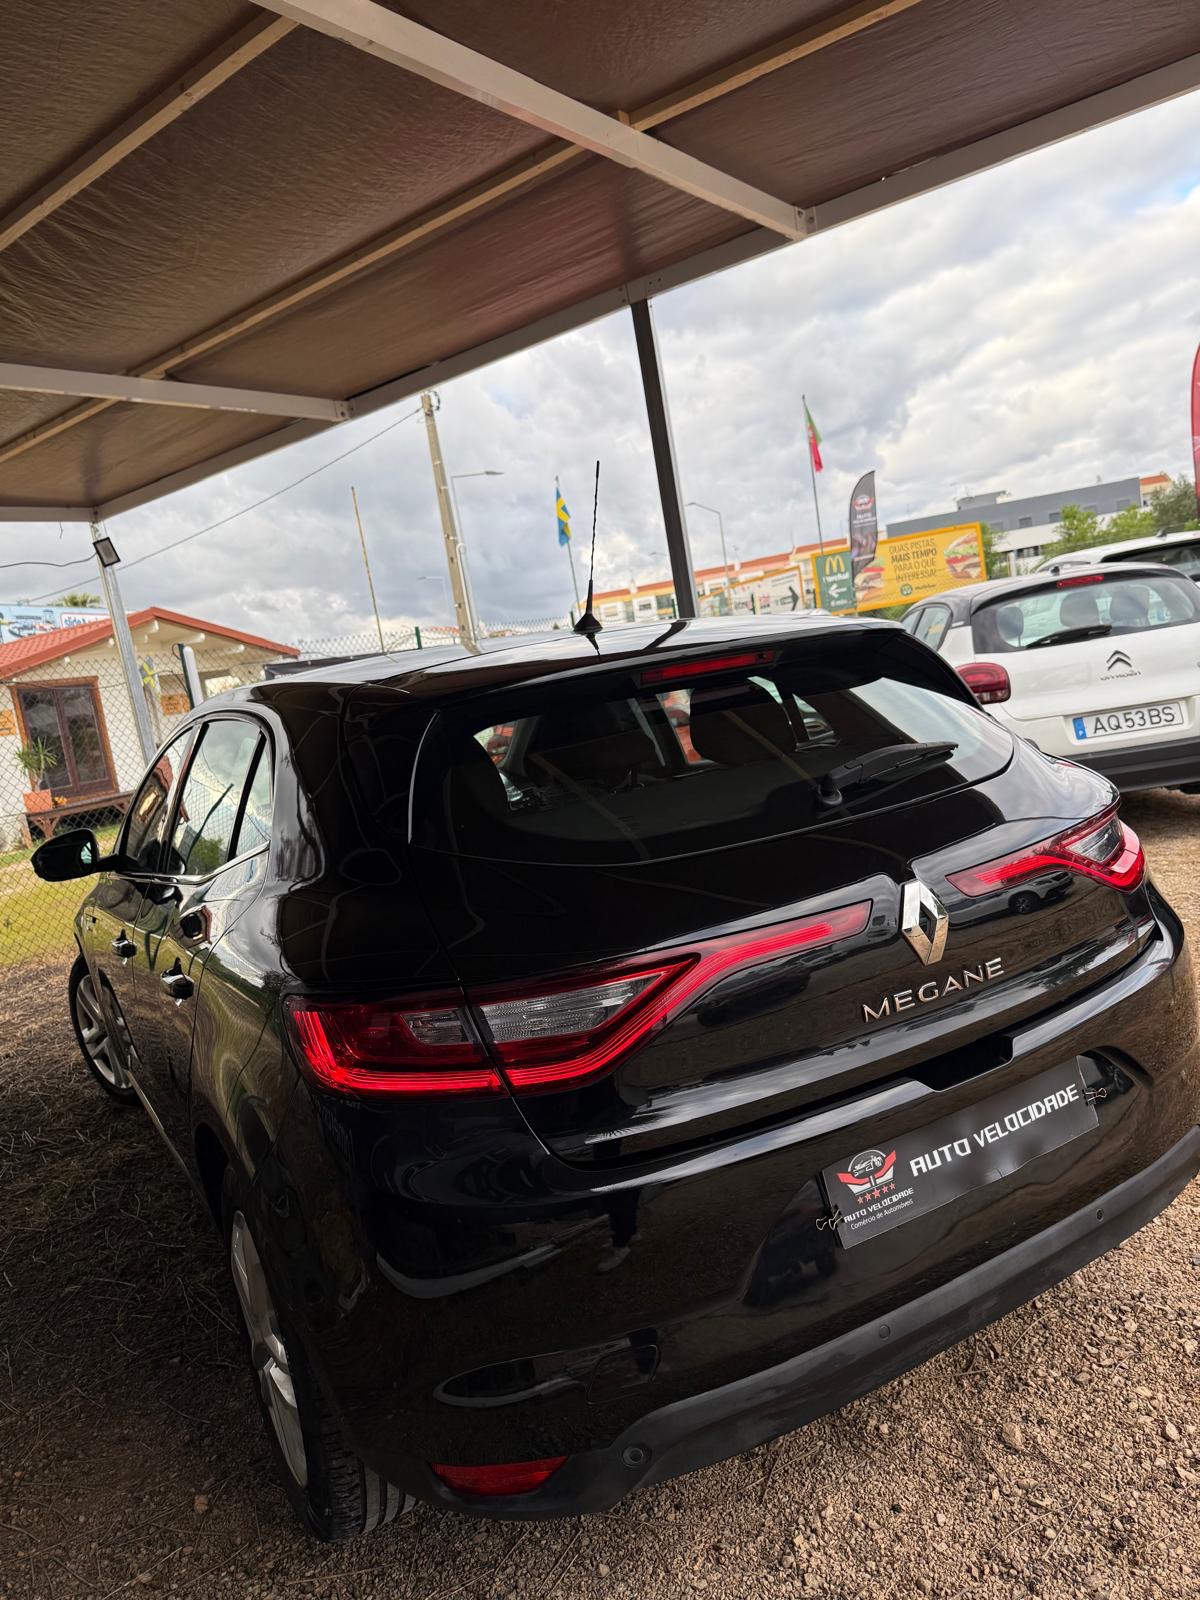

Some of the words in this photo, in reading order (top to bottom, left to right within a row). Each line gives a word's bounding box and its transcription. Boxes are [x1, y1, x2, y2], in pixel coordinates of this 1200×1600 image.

[891, 552, 911, 564] MAIS
[912, 547, 937, 560] TEMPO
[894, 562, 913, 574] PARA
[914, 560, 920, 569] O
[921, 557, 936, 569] QUE
[862, 957, 1005, 1023] MEGANE
[909, 1137, 972, 1177] AUTO
[973, 1083, 1080, 1148] VELOCIDADE
[843, 1208, 867, 1224] AUTO
[867, 1187, 915, 1213] VELOCIDADE
[850, 1215, 876, 1230] Comércio
[876, 1211, 884, 1220] de
[884, 1198, 914, 1217] Automóveis
